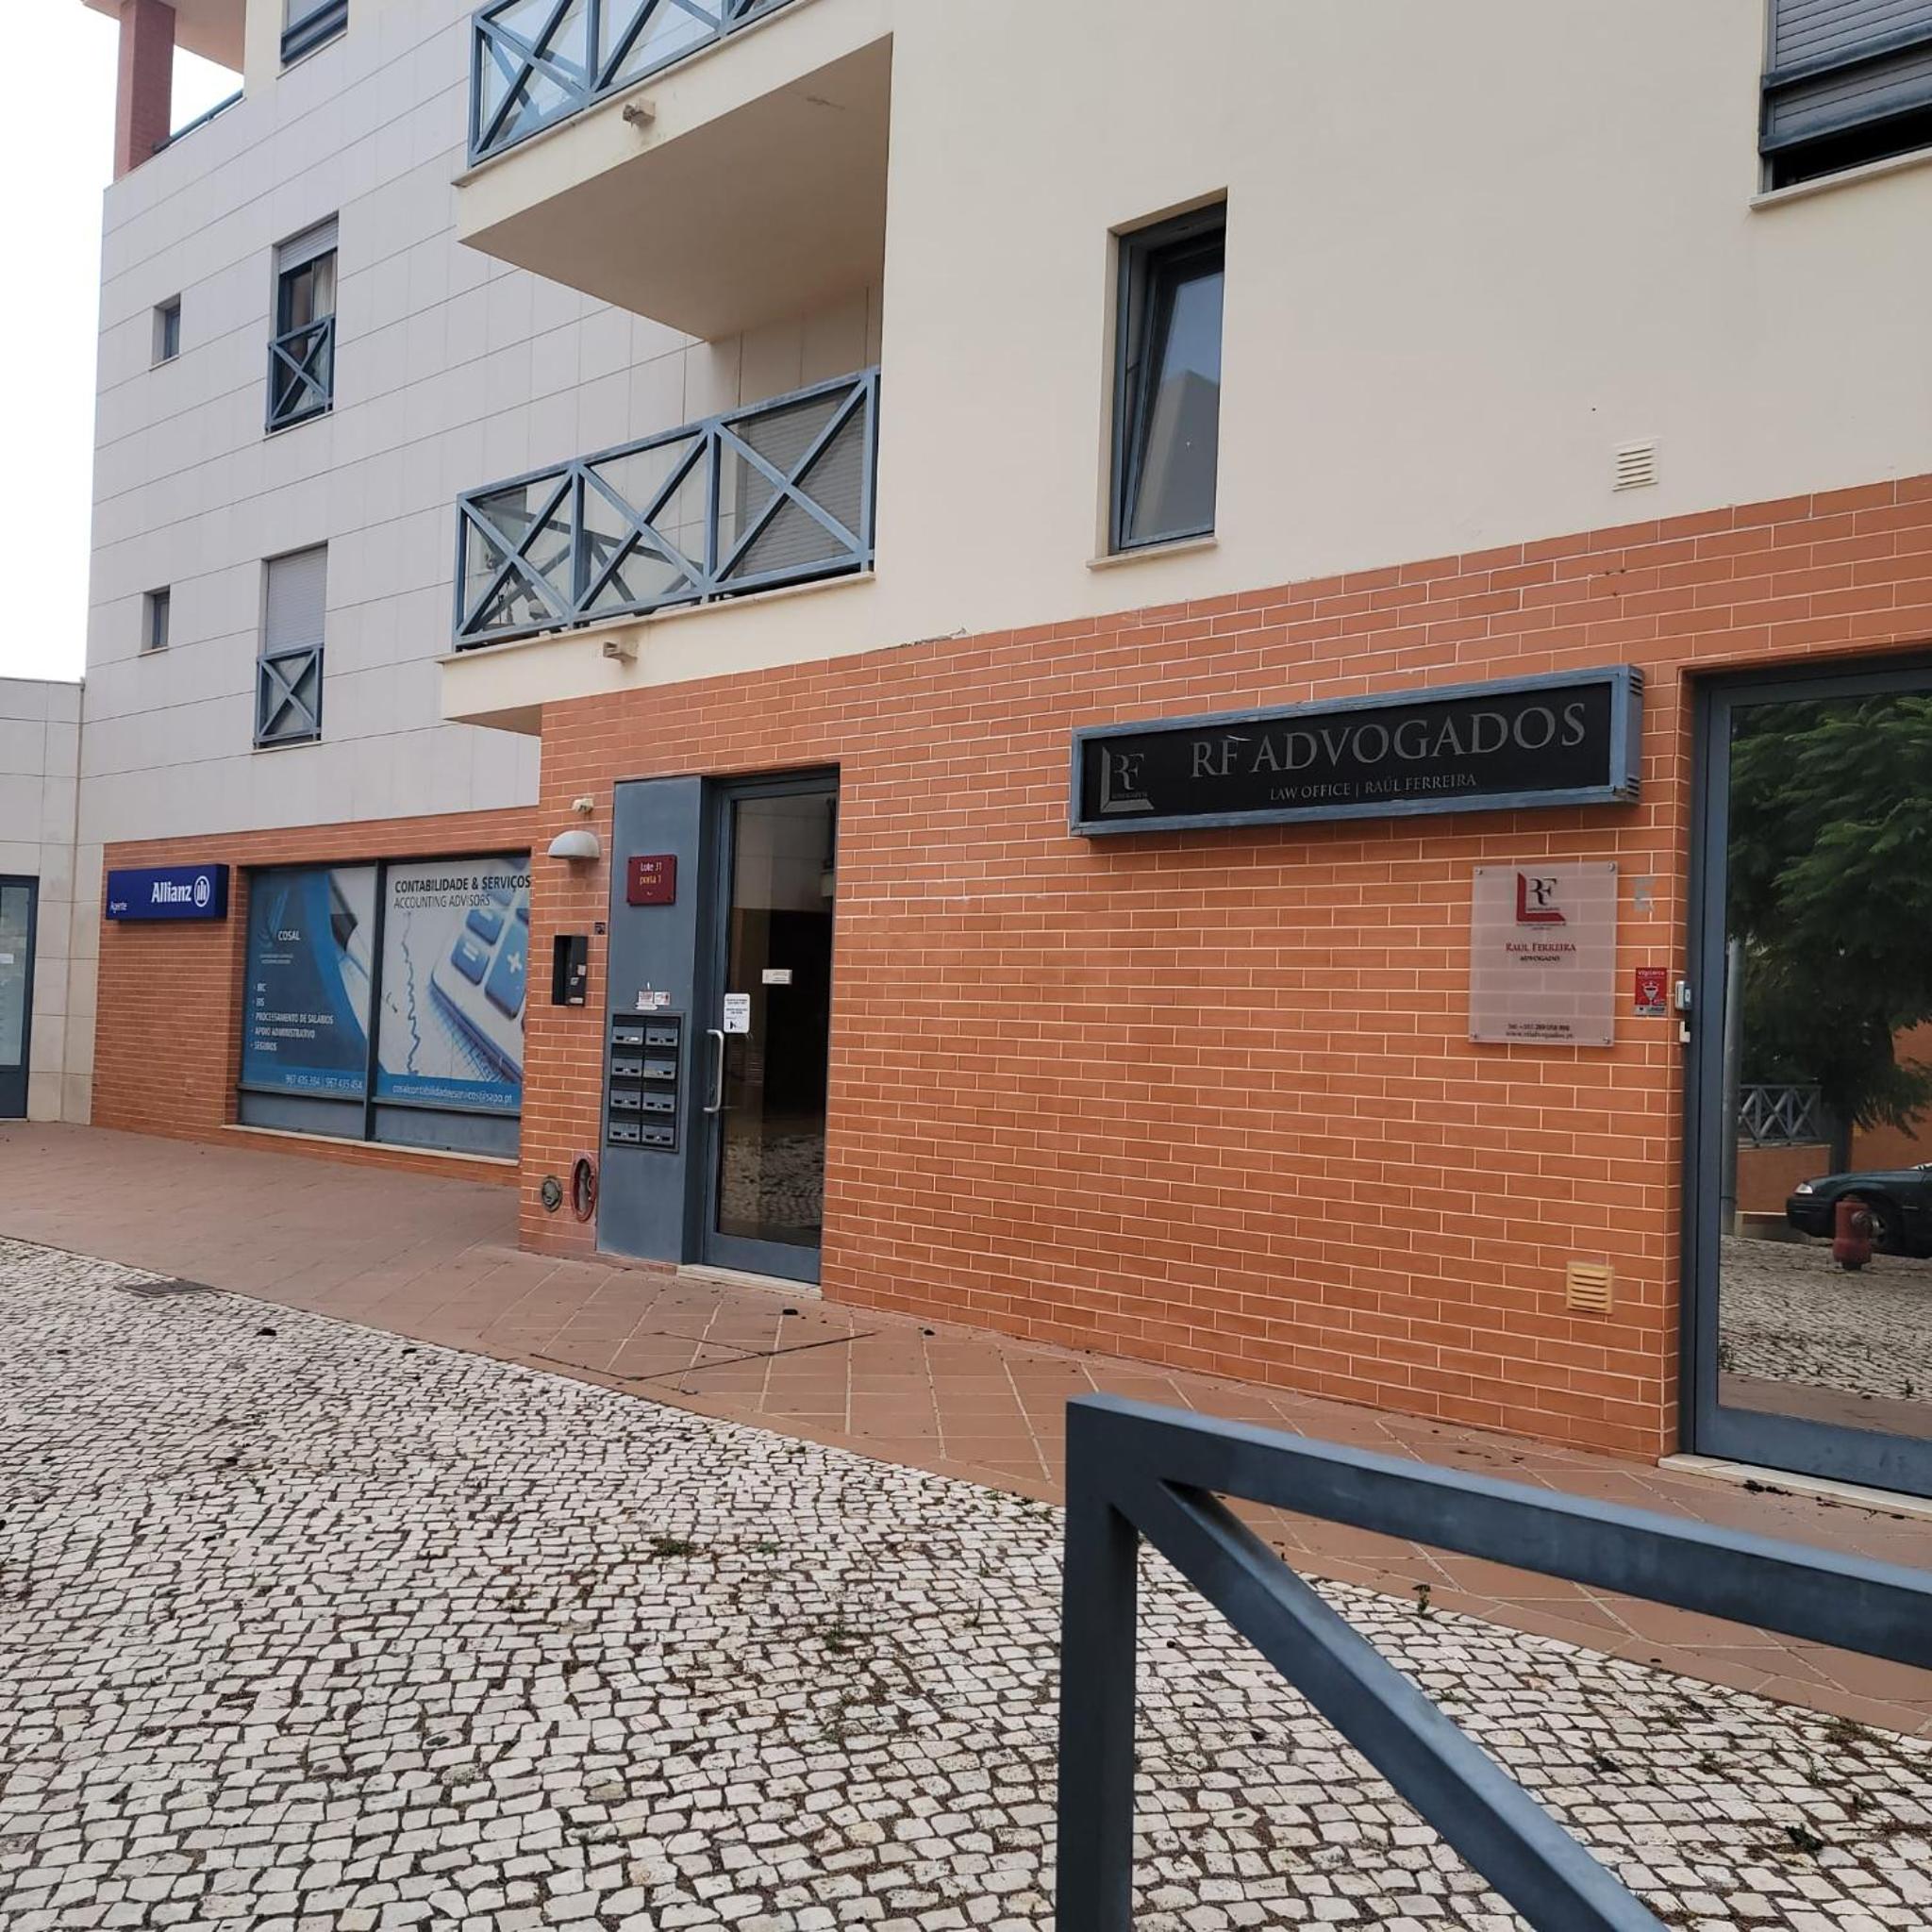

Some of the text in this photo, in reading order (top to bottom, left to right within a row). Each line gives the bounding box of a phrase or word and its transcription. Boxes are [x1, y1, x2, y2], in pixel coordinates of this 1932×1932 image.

[1191, 703, 1586, 778] RF ADVOGADOS
[1271, 786, 1297, 801] LAW
[1301, 783, 1351, 799] OFFICE
[1405, 774, 1477, 791] FERREIRA
[151, 881, 192, 903] Allianz
[394, 874, 532, 893] CONTABILIDADE & SERVIÇOS
[394, 893, 491, 909] ACCOUNTING ADVISORS
[277, 930, 301, 941] COSAL
